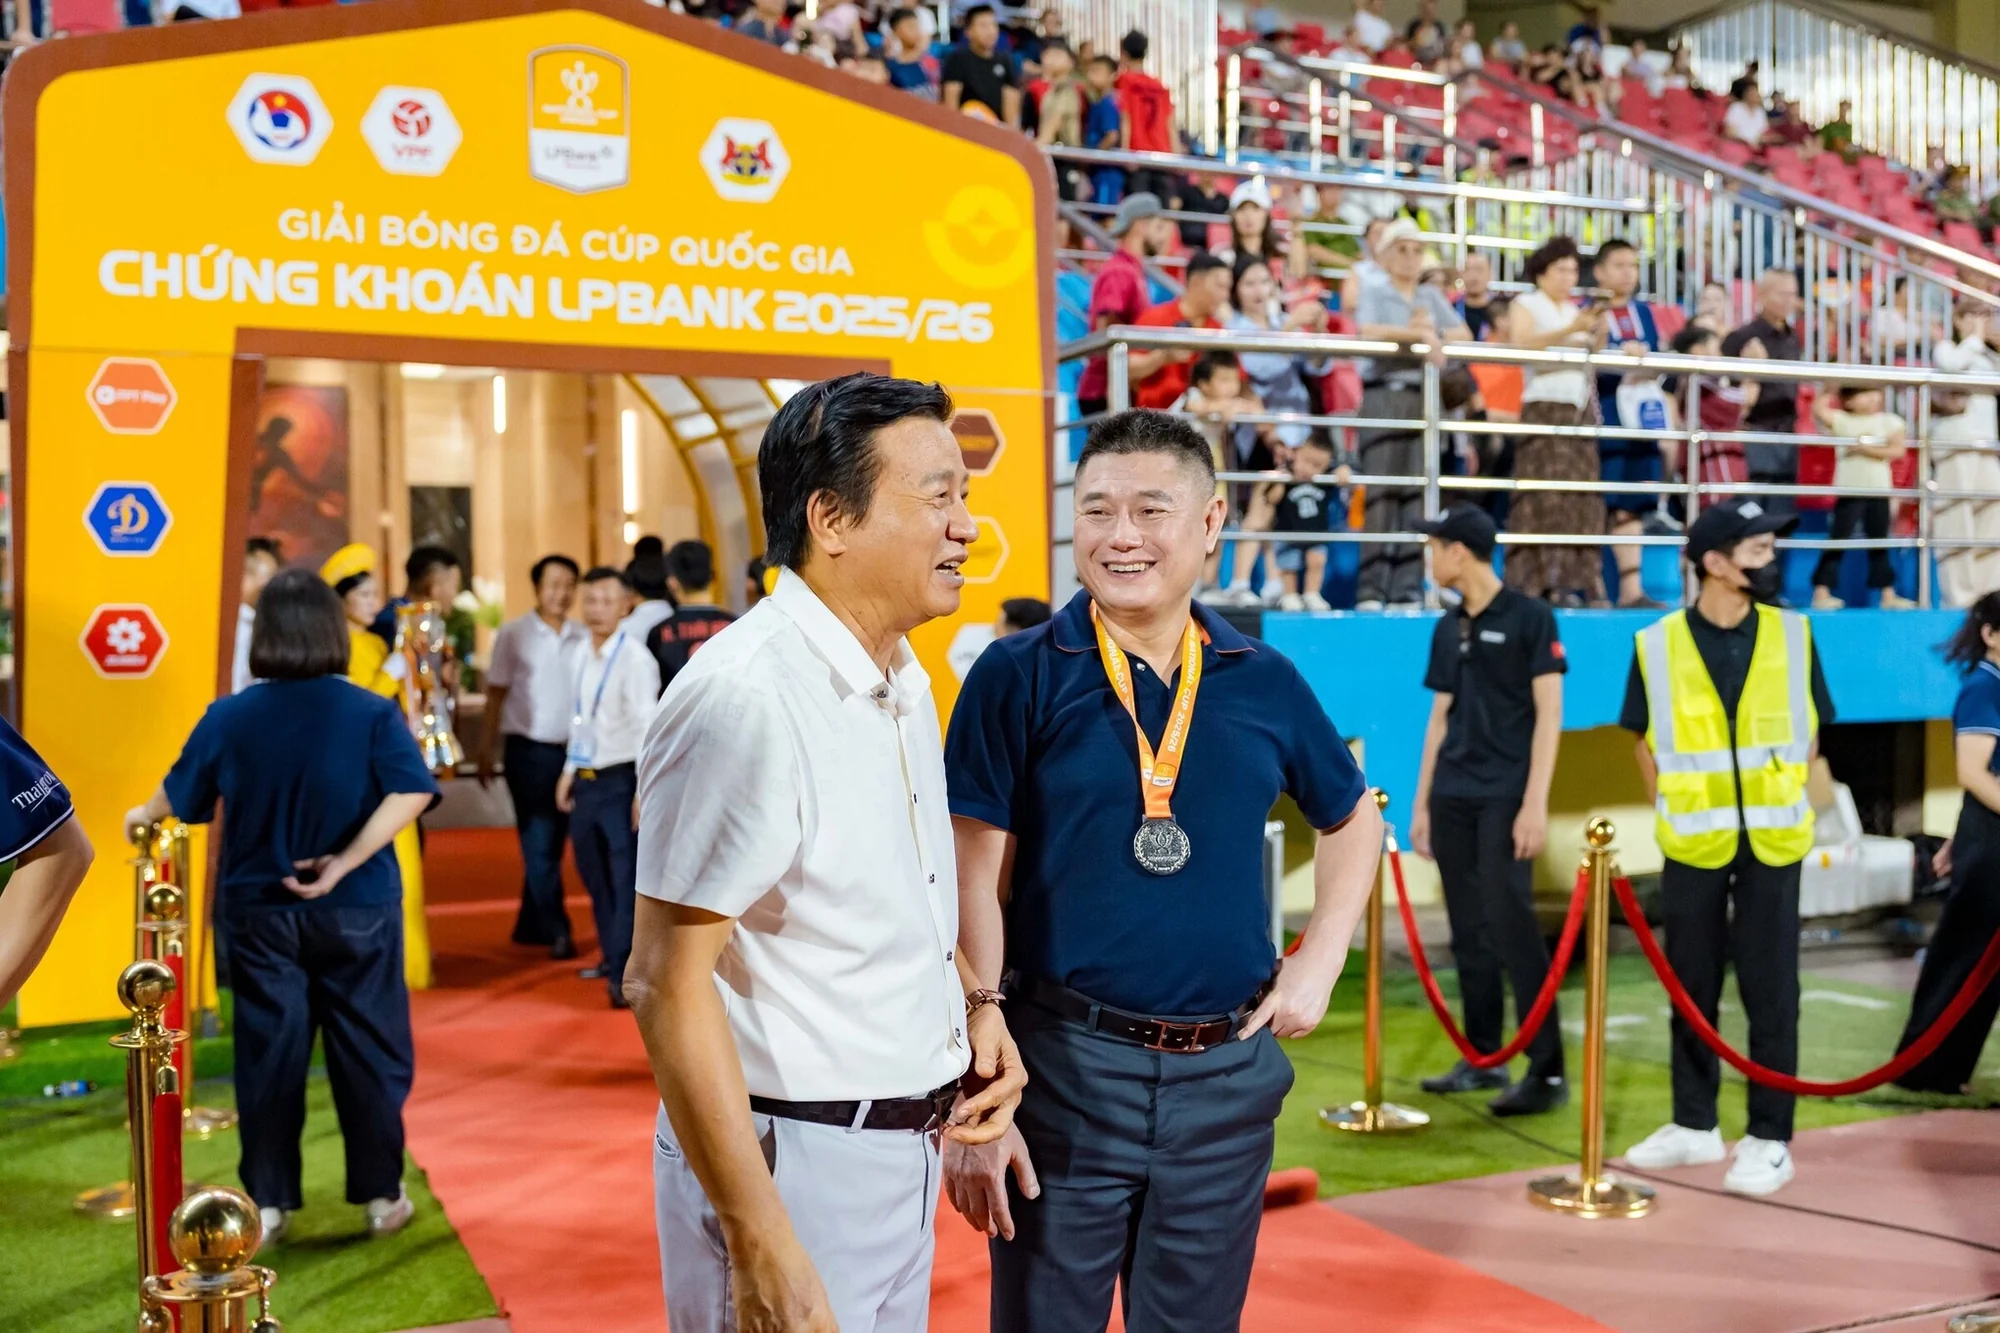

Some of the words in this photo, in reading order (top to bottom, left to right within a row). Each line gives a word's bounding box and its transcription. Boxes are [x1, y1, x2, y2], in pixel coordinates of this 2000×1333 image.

[278, 201, 365, 244] GIẢI
[379, 211, 499, 254] BÓNG
[511, 220, 570, 258] ĐÁ
[580, 225, 660, 263] CÚP
[669, 230, 781, 273] QUỐC
[790, 244, 855, 277] GIA
[99, 244, 319, 306] CHỨNG
[334, 261, 535, 319] KHOÁN
[548, 277, 765, 332] LPBANK
[773, 290, 994, 344] 2025/26
[1115, 672, 1129, 694] CUP
[1186, 639, 1197, 685] NATIONAL
[1180, 687, 1192, 710] CUP
[1167, 711, 1185, 752] 2025/26
